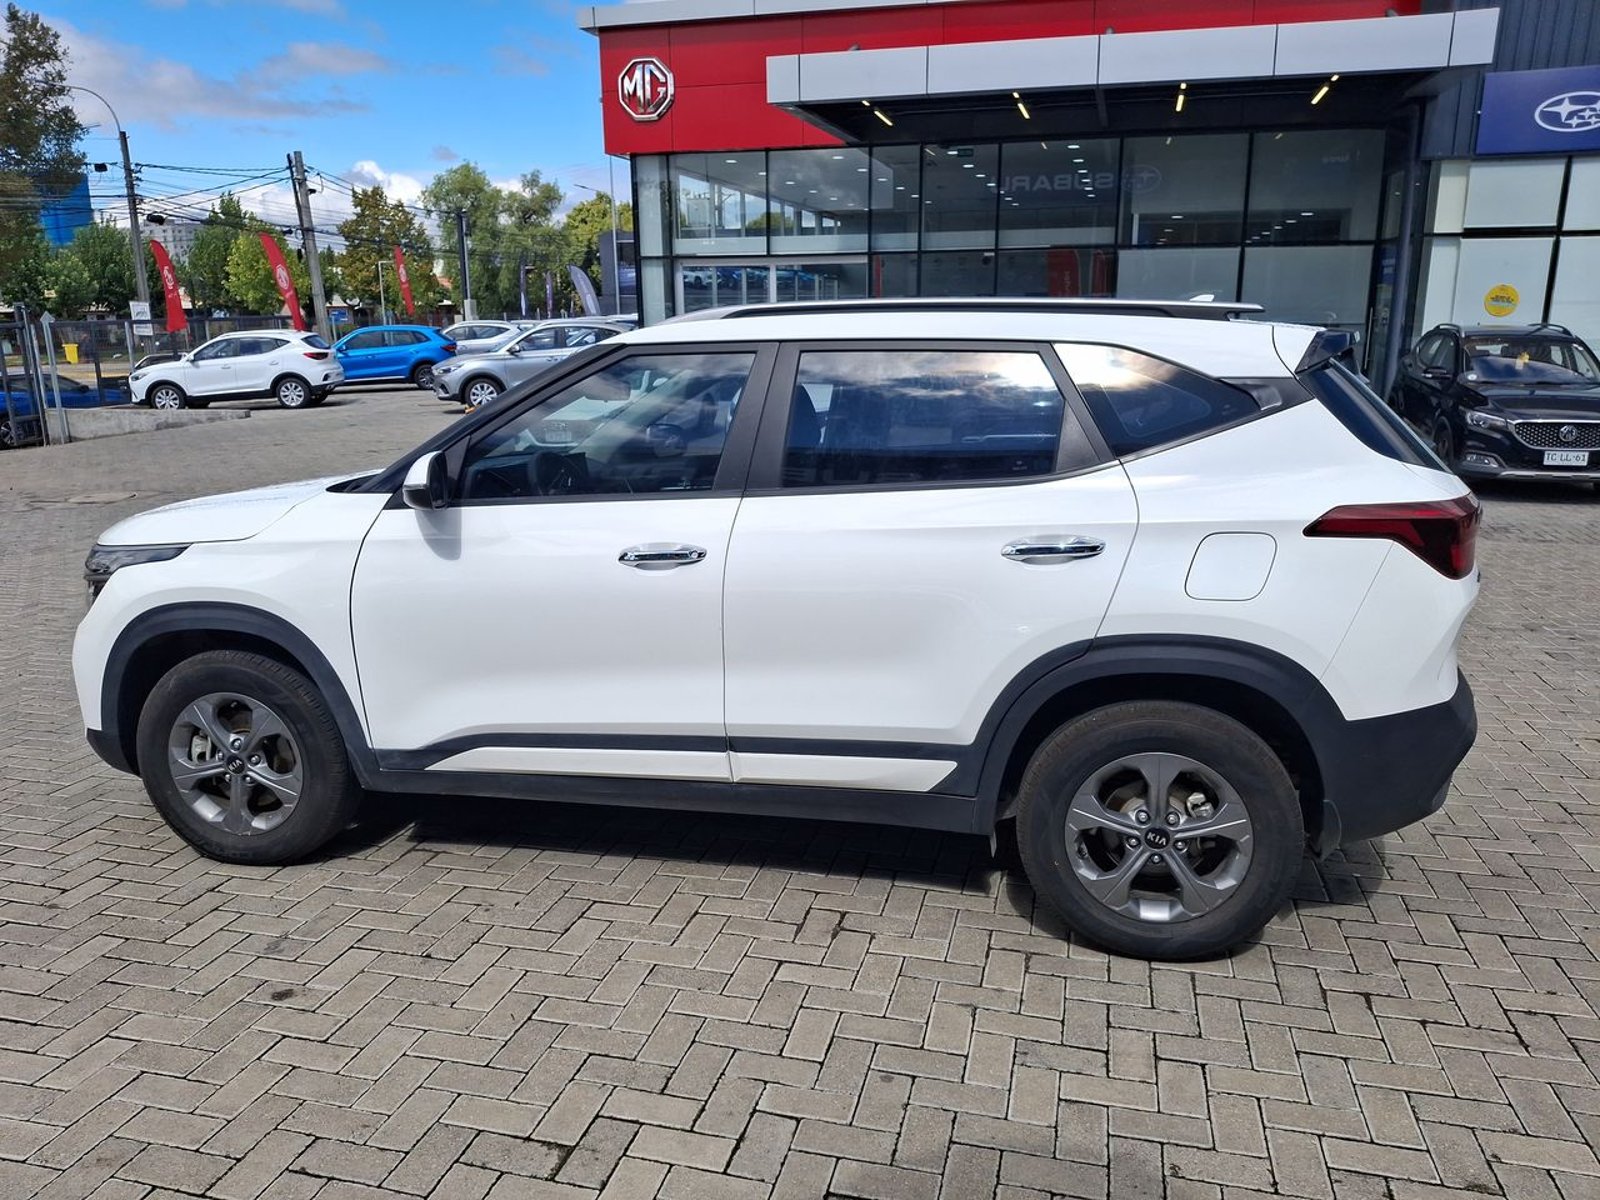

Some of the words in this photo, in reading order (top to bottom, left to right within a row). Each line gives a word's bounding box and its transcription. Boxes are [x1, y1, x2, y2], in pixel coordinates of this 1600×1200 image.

[622, 62, 668, 114] MG
[228, 759, 243, 771] KIA
[1146, 831, 1167, 846] KIA
